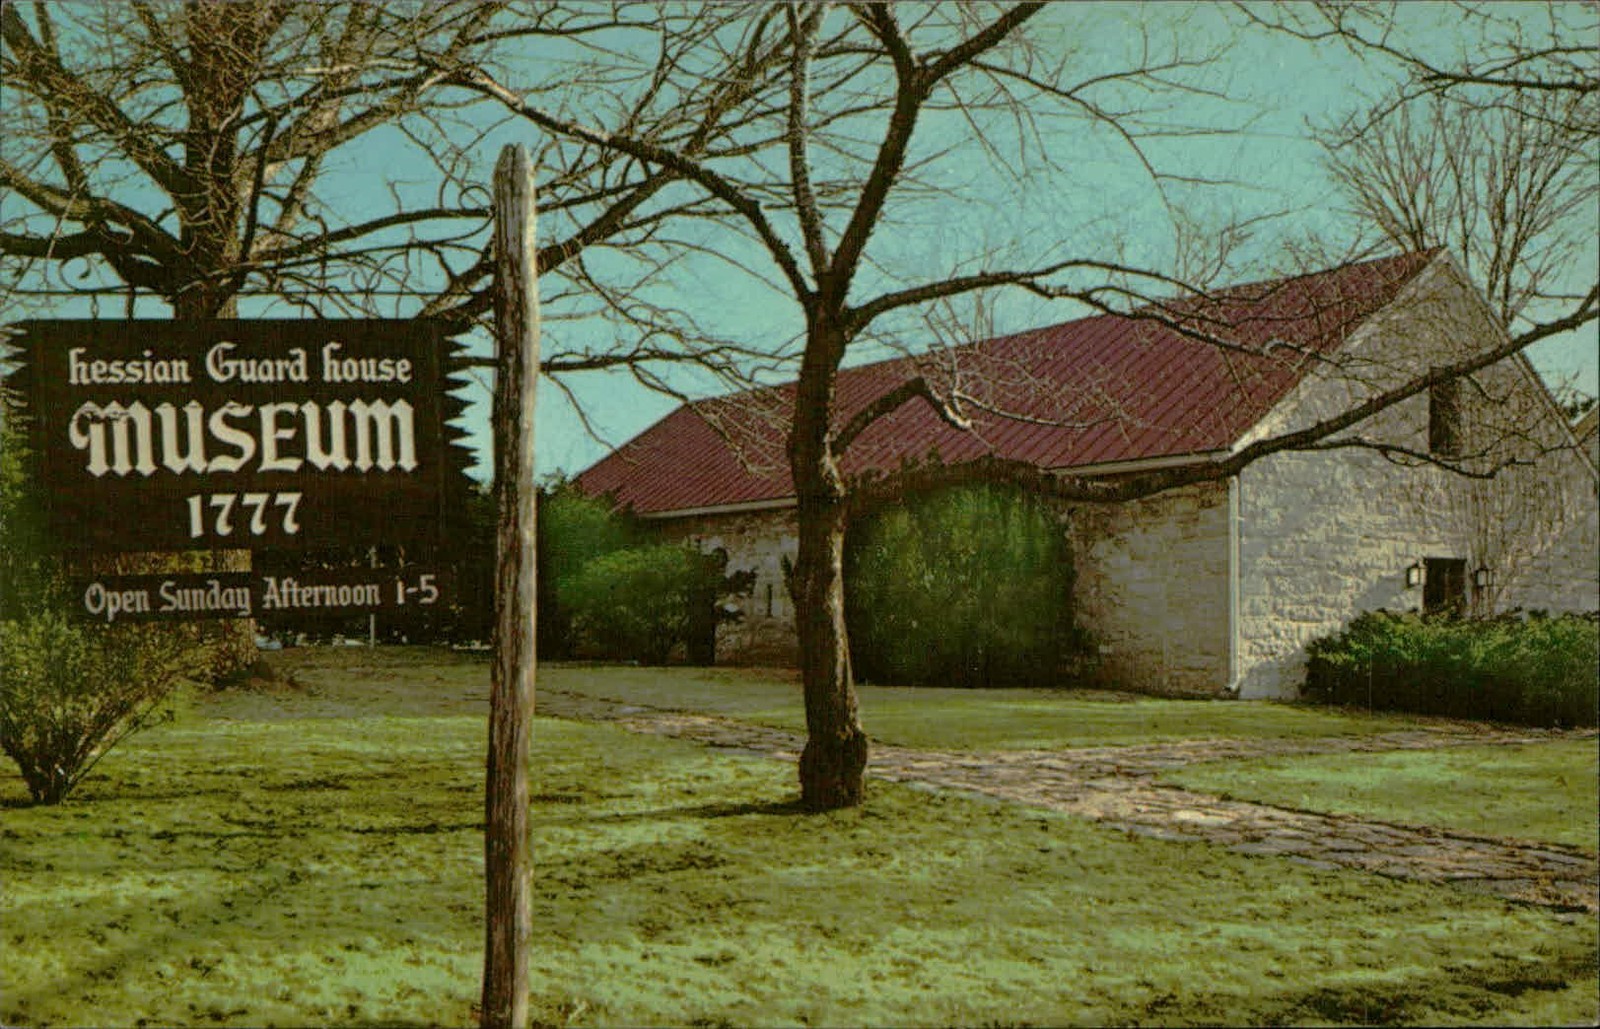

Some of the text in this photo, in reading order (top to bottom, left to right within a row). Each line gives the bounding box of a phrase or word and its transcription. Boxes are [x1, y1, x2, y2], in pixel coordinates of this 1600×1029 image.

[205, 341, 308, 383] Guard
[68, 399, 418, 477] MUSEUM
[187, 492, 302, 538] 1777
[84, 574, 439, 622] Open Sunday Afternoon 1-5
